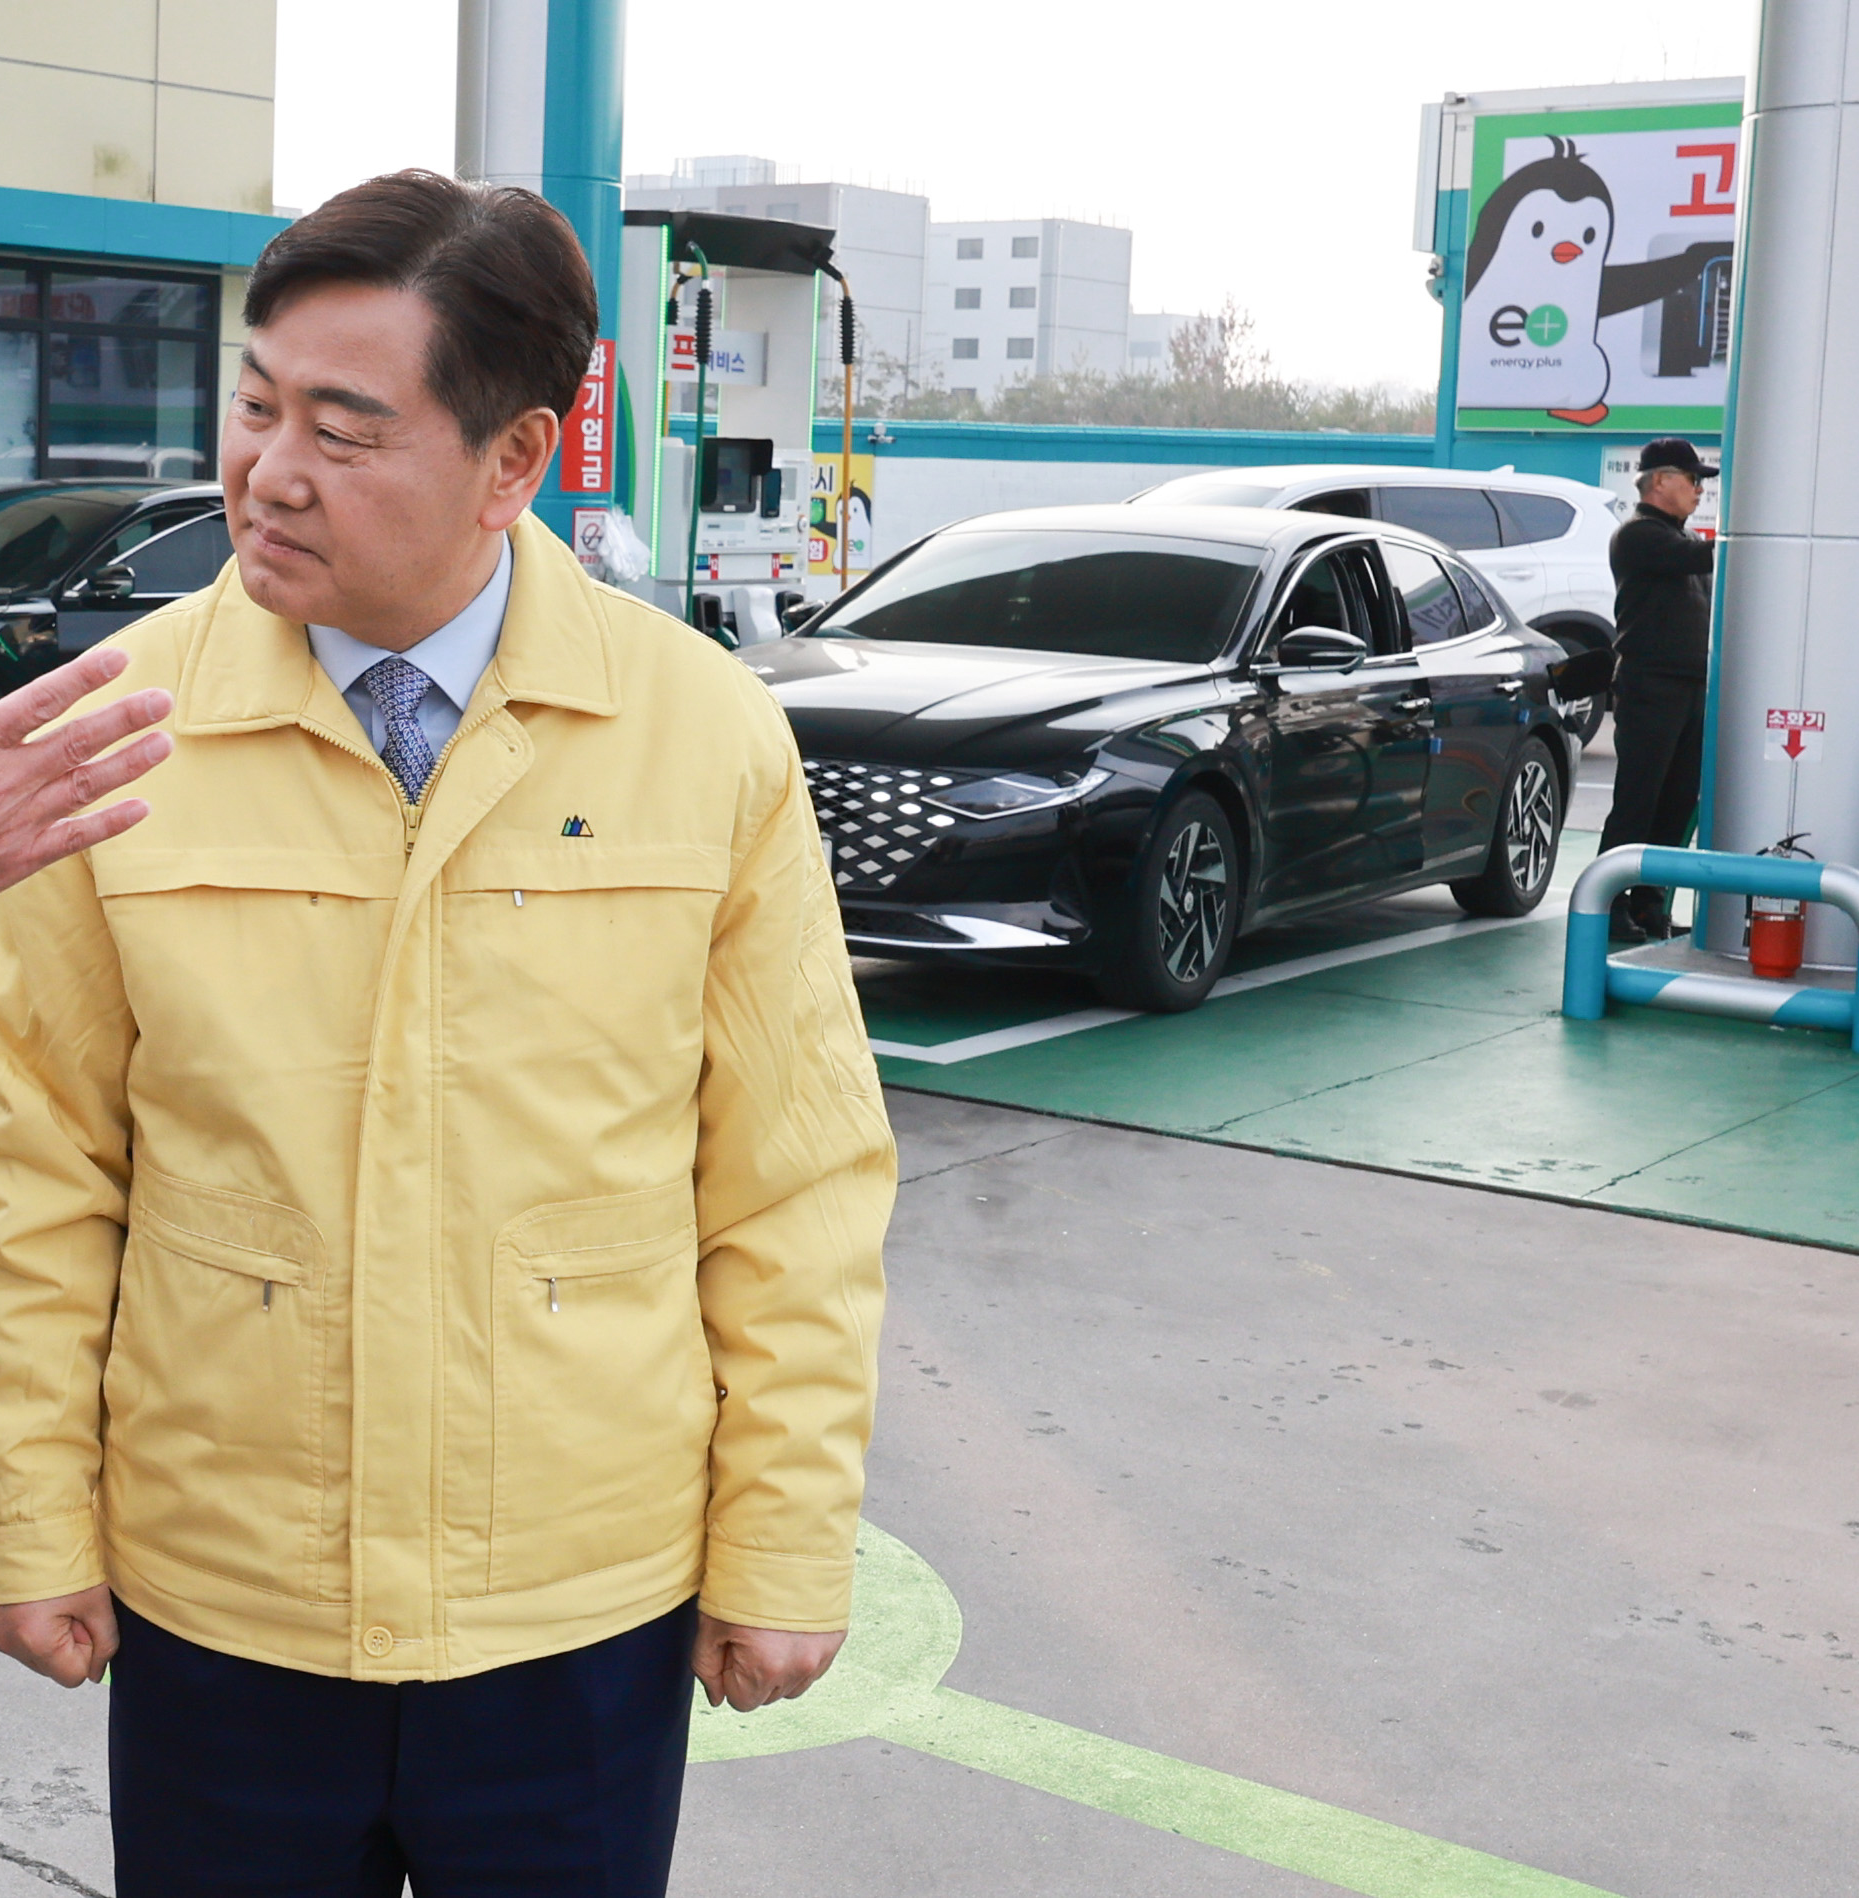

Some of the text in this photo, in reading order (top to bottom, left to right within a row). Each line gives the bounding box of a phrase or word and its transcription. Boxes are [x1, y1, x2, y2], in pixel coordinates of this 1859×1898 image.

[1669, 143, 1735, 217] 고
[1490, 356, 1562, 369] energy plus
[581, 344, 606, 489] 화기엄금
[1769, 711, 1823, 728] 소화기
